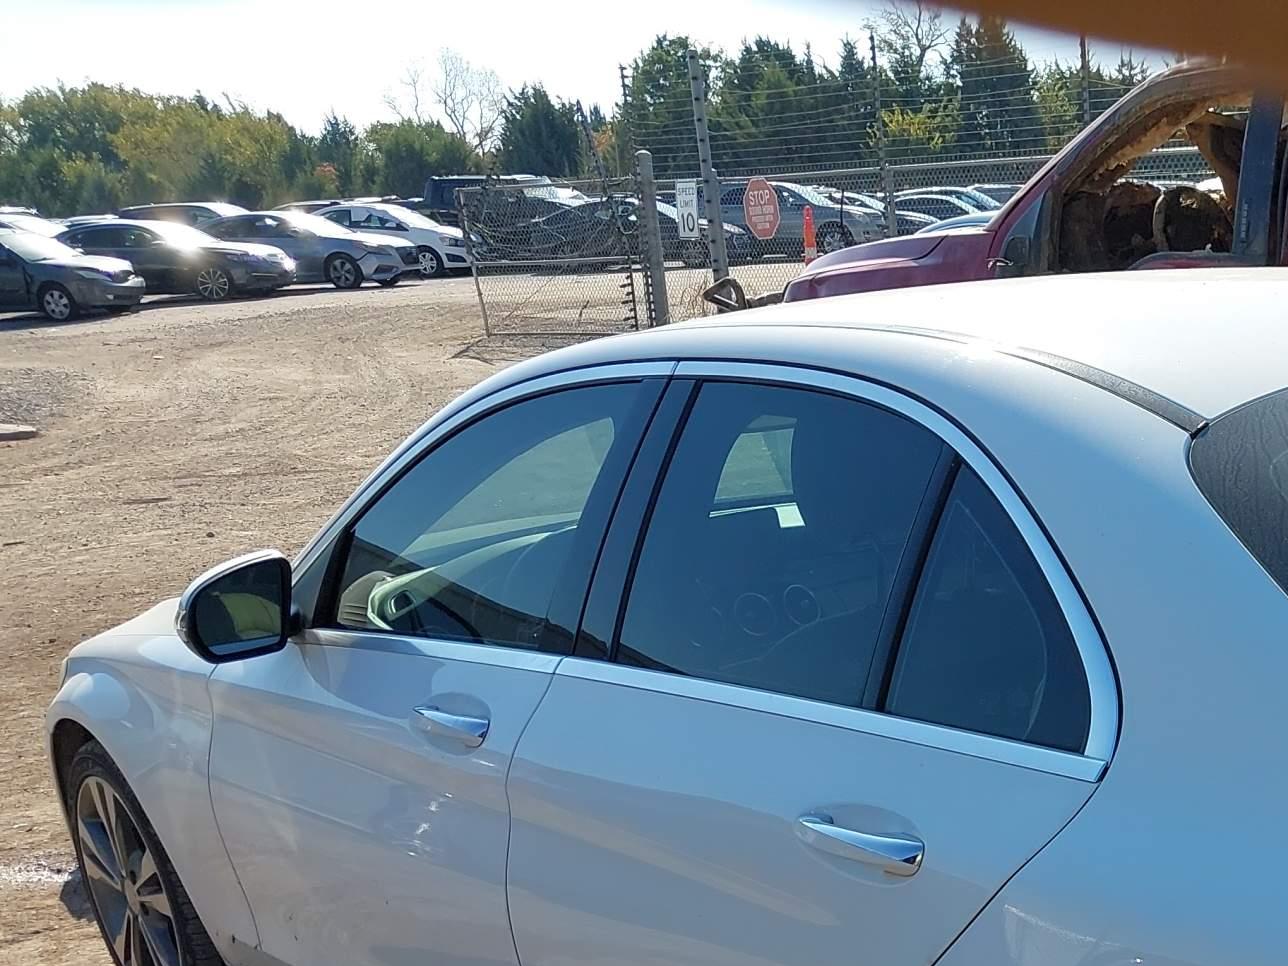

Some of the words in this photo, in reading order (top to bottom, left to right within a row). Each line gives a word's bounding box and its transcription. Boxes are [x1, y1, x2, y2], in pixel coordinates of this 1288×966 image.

[679, 199, 694, 208] LIMIT
[748, 189, 770, 206] STOP
[681, 212, 695, 233] 10
